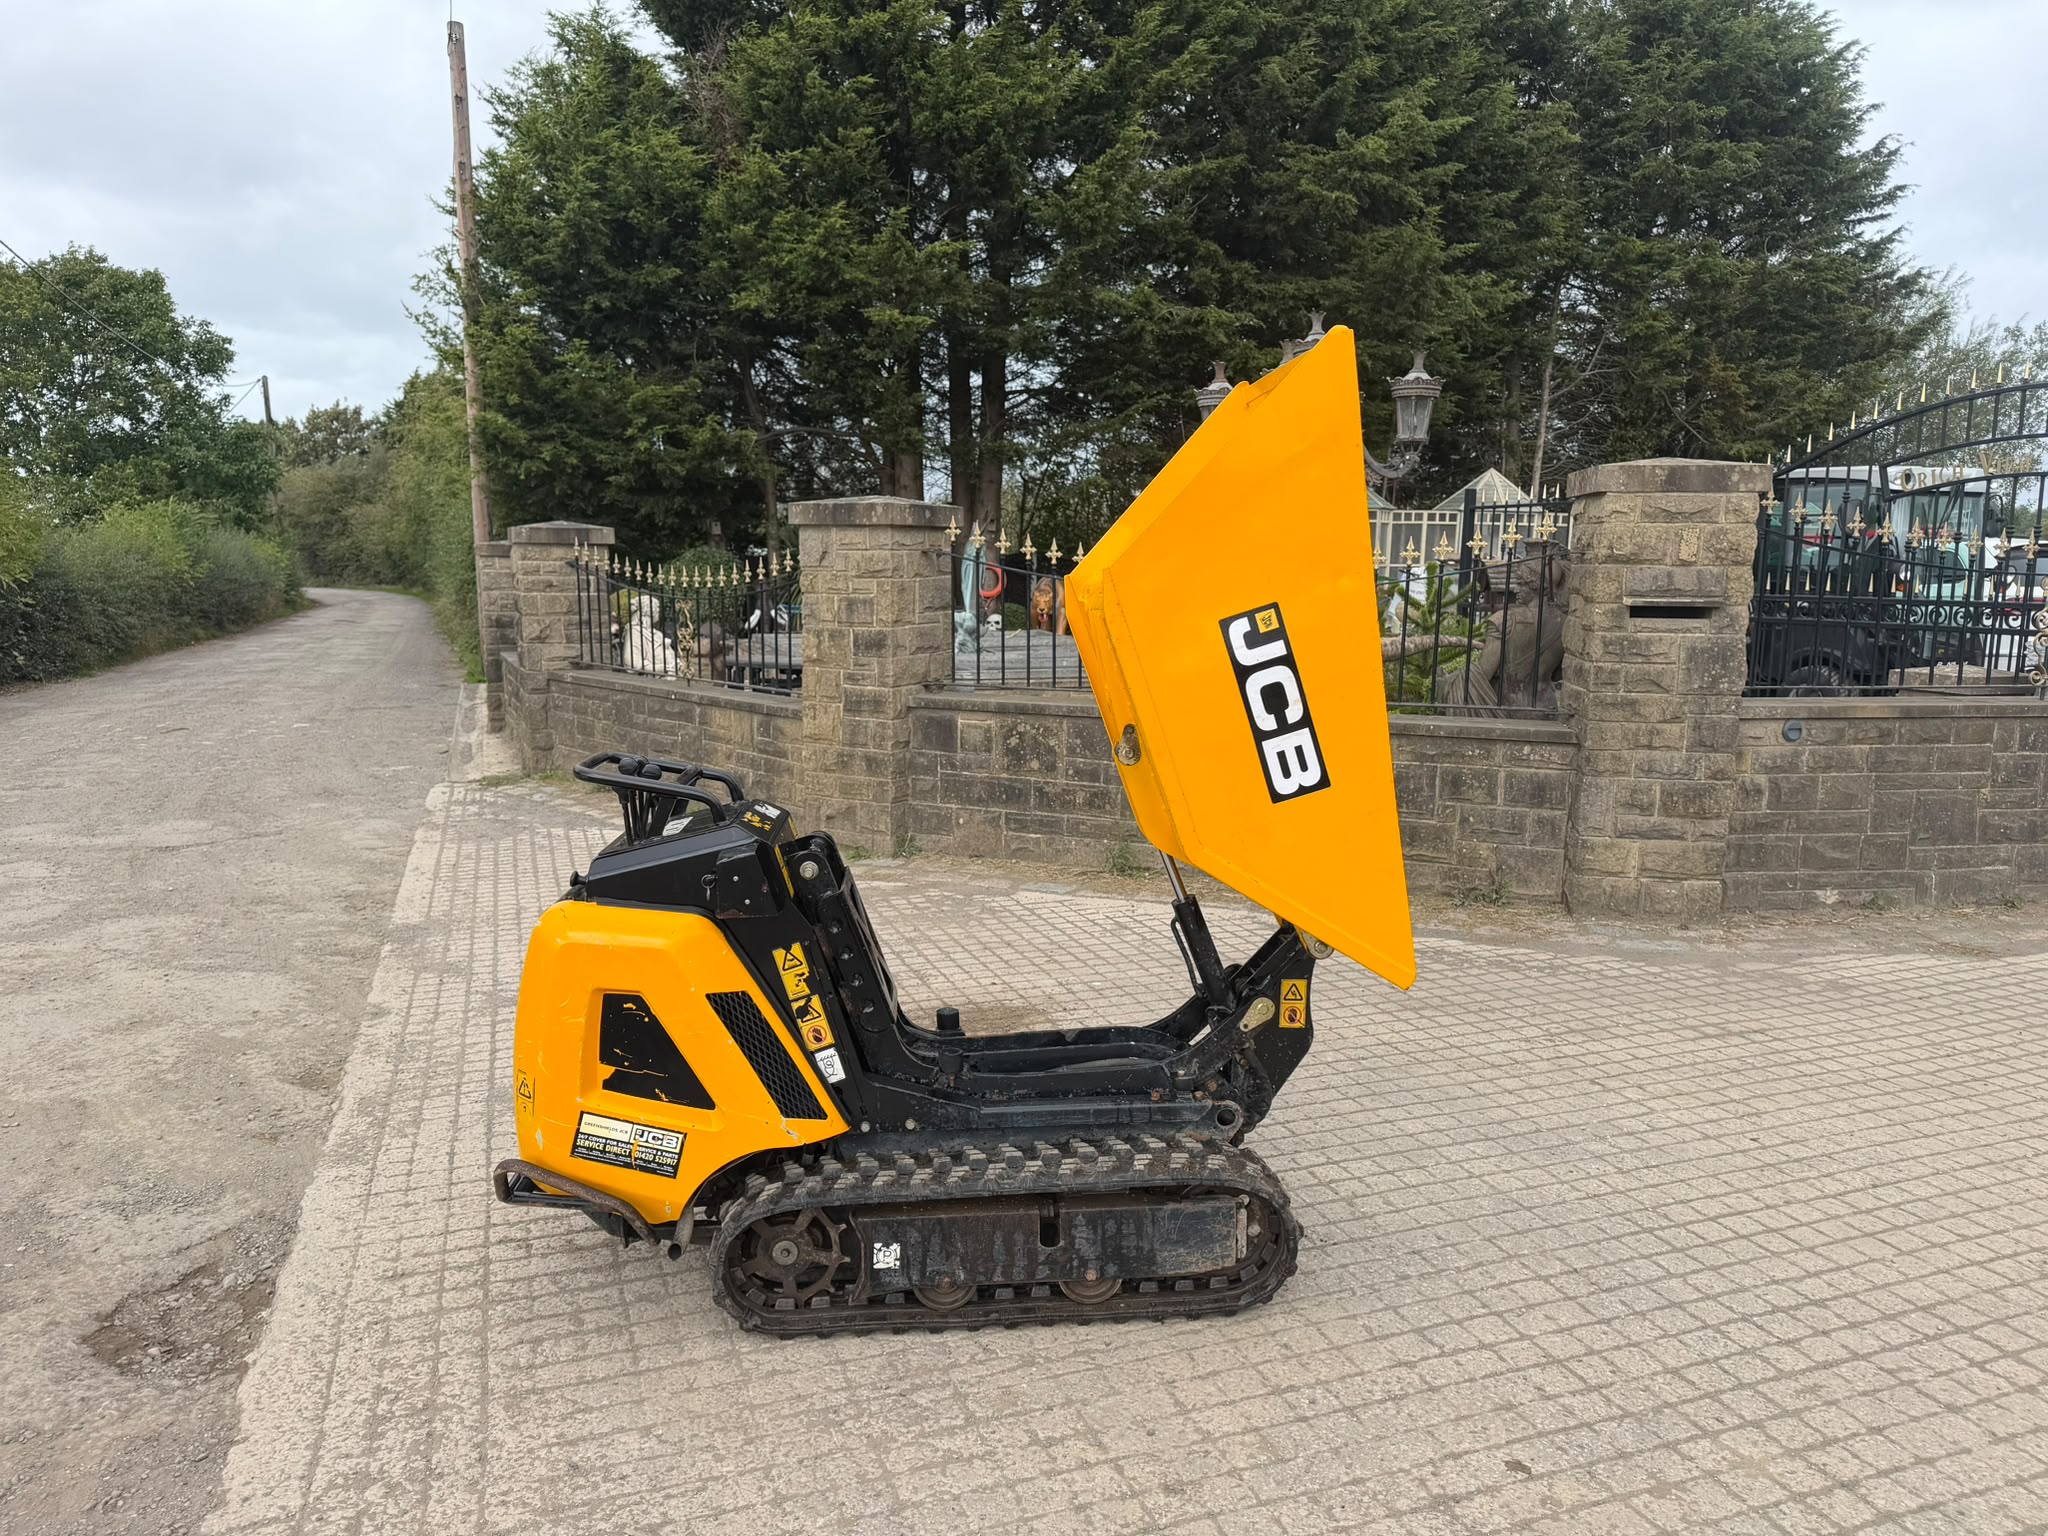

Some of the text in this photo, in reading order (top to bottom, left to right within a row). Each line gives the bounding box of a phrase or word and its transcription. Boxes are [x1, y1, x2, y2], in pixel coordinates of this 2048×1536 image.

[1900, 463, 1965, 492] CRICH
[1228, 616, 1322, 795] JCB
[589, 1135, 605, 1143] COVER
[662, 1151, 678, 1159] PARTS
[635, 1129, 678, 1148] JCB
[576, 1139, 604, 1151] SERVICE
[605, 1144, 630, 1156] DIRECT
[635, 1151, 654, 1161] 01420
[655, 1155, 678, 1166] 525917
